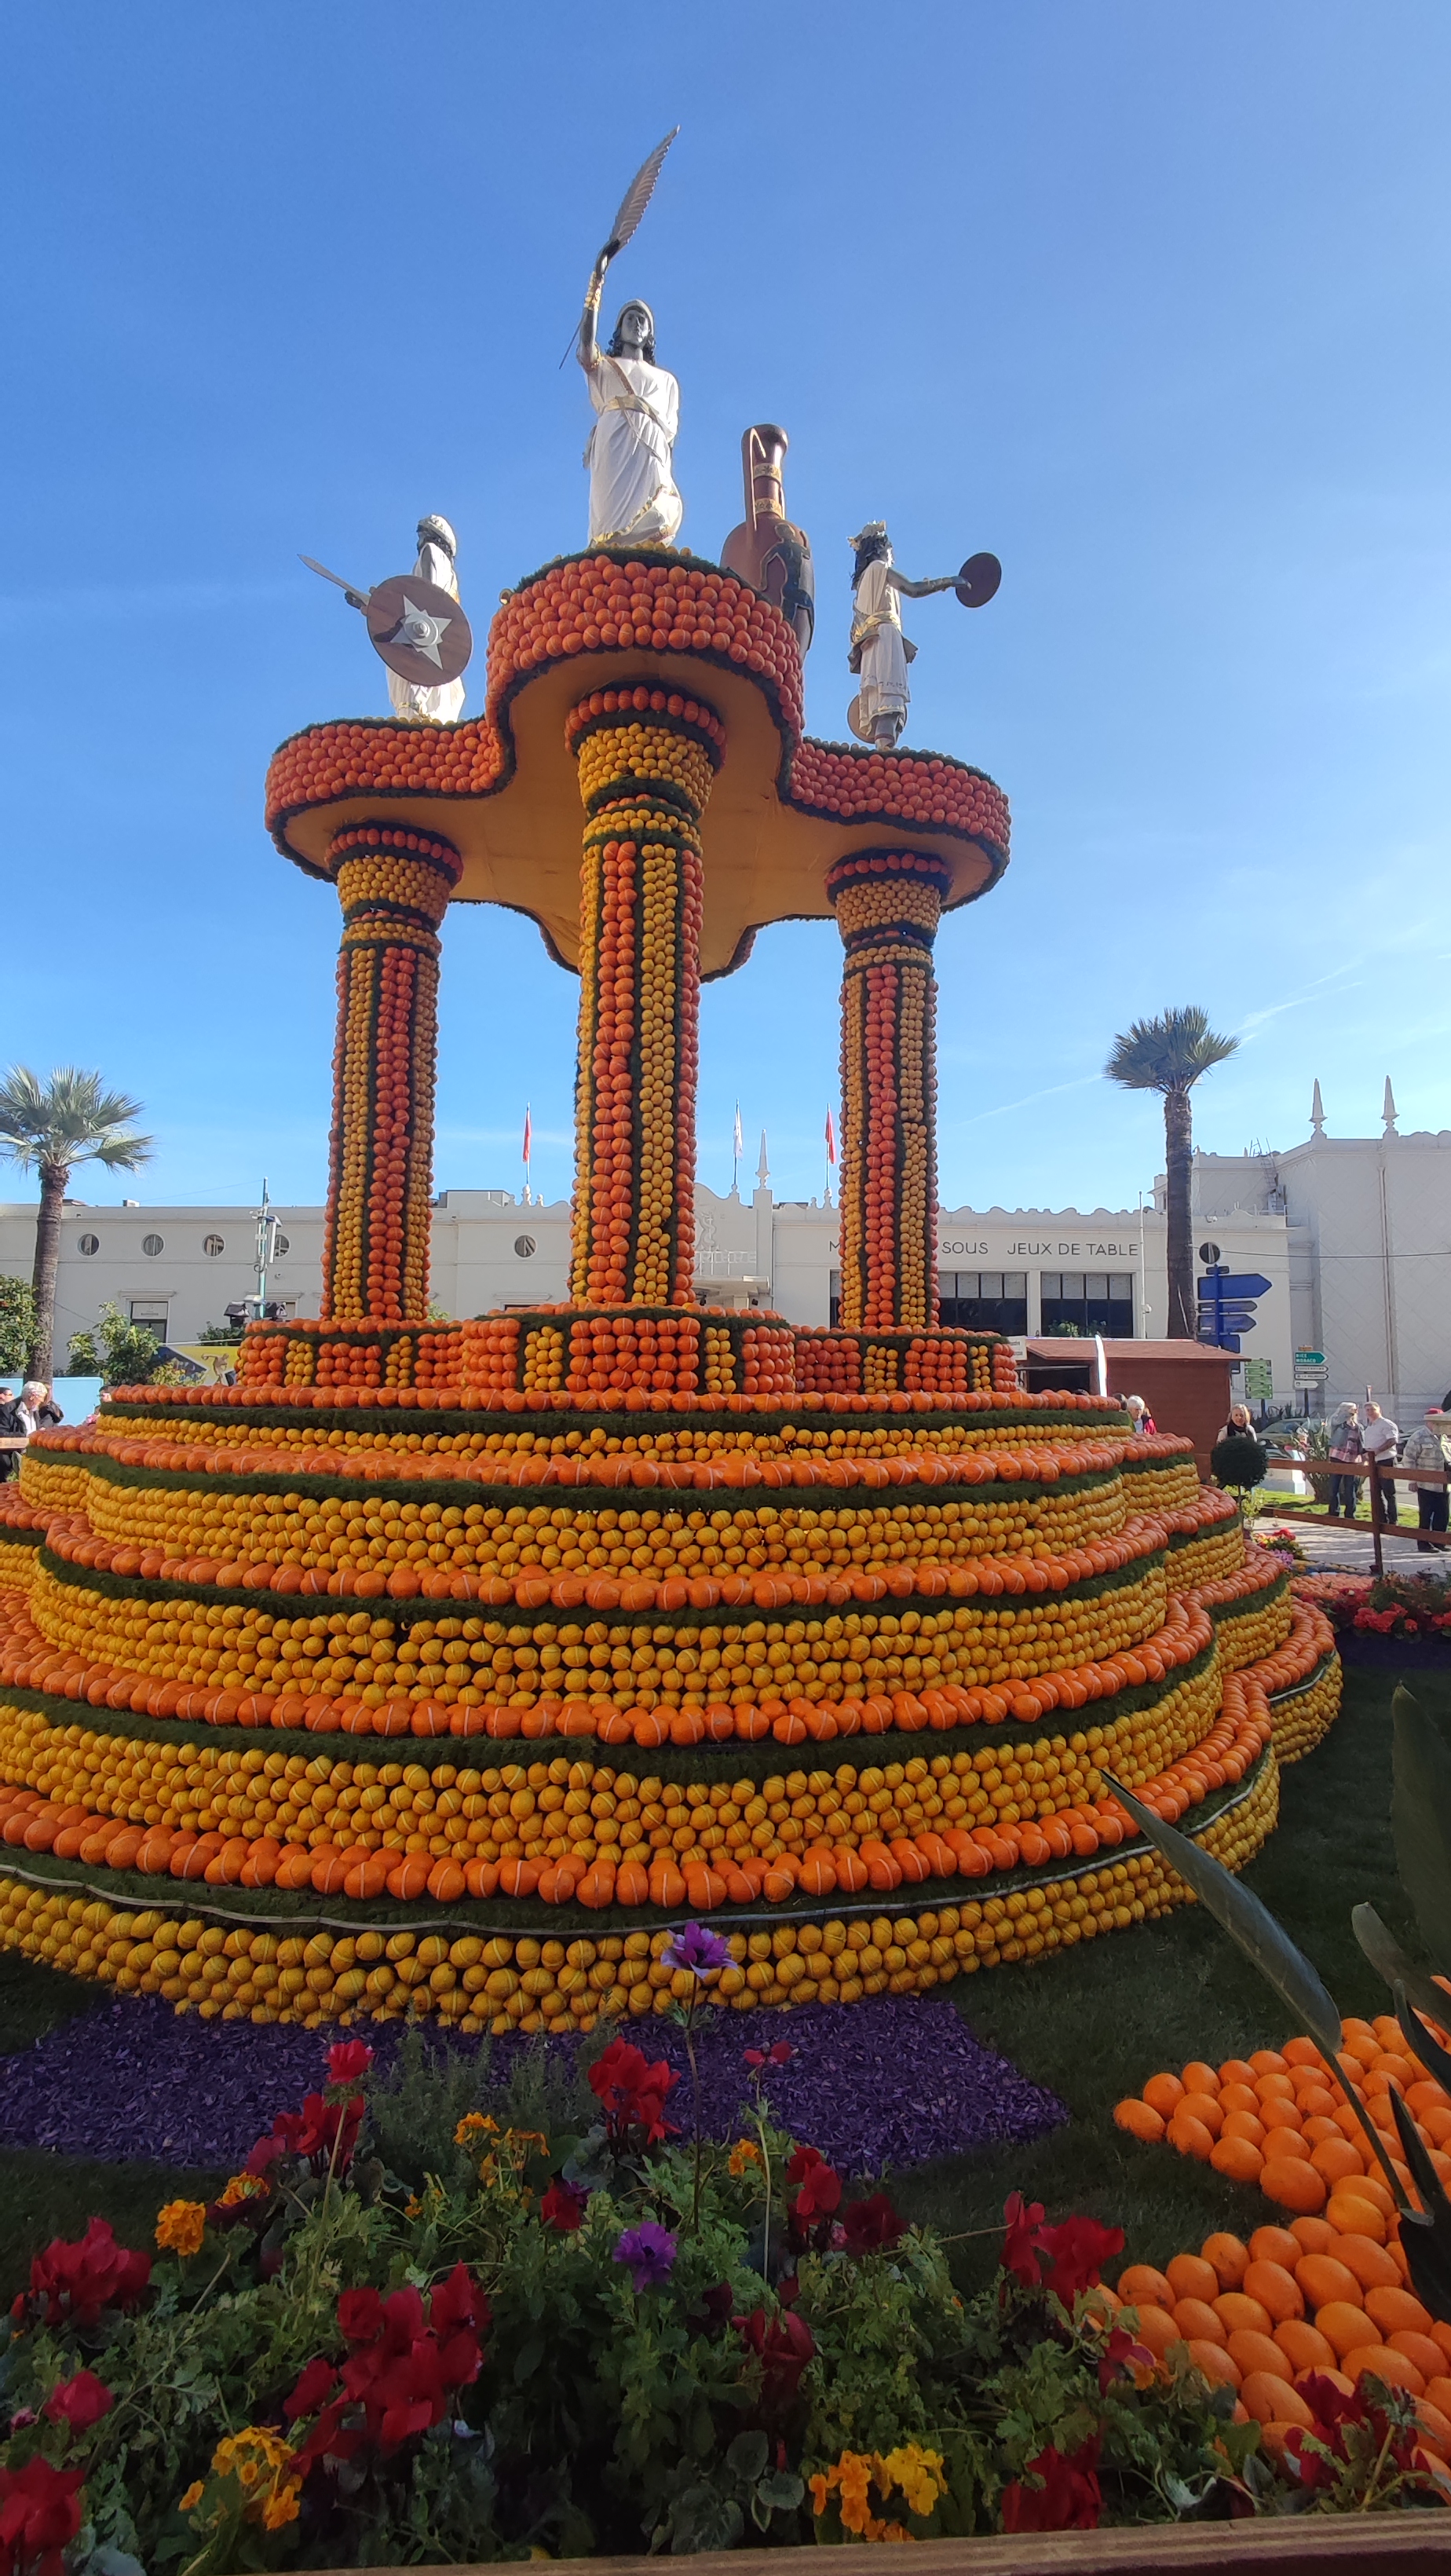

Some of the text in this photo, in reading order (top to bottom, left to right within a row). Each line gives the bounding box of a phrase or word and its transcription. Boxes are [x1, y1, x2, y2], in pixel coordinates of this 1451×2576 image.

[941, 1241, 989, 1255] SOUS
[1007, 1242, 1139, 1257] JEUX DE TABLE
